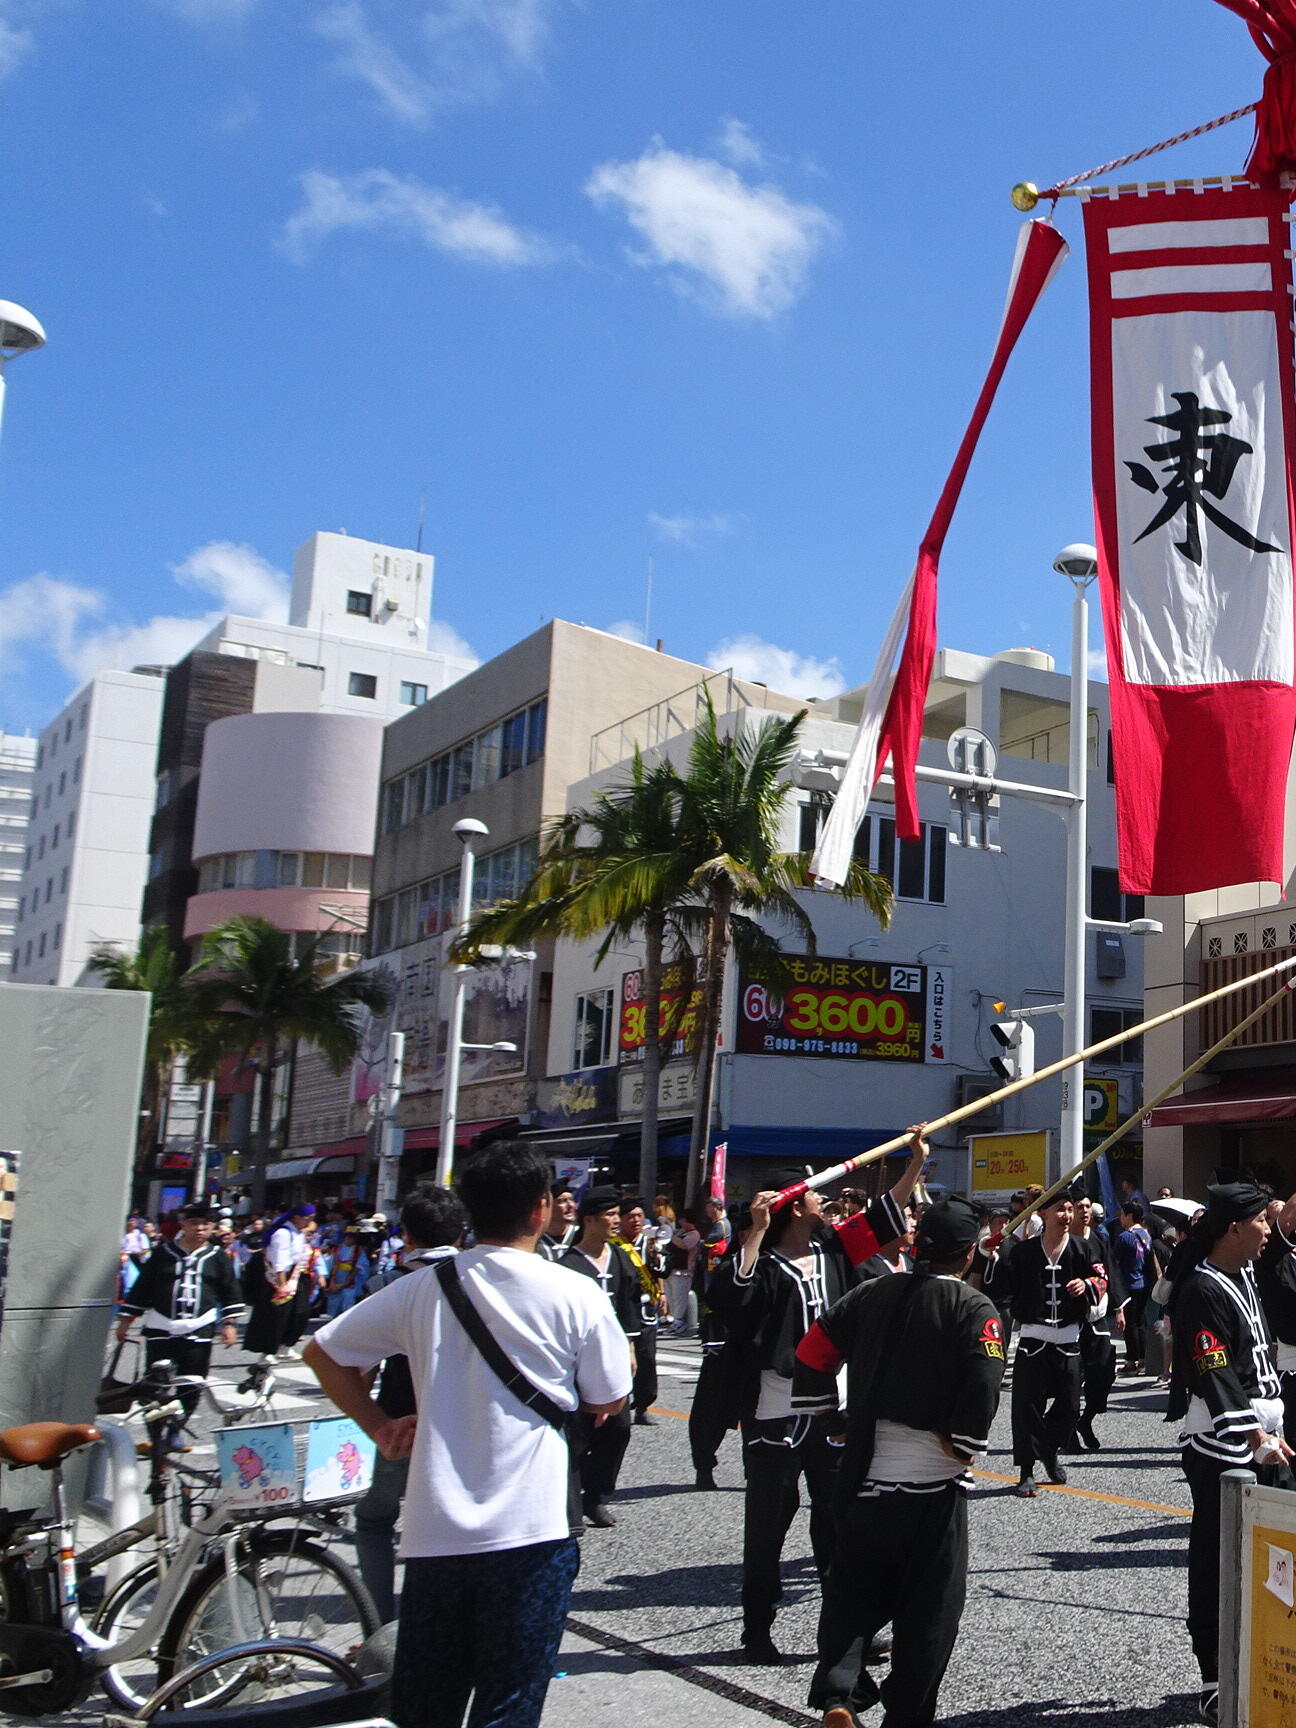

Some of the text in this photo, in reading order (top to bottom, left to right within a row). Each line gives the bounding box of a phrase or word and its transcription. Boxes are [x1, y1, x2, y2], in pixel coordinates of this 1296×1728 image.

[893, 969, 919, 989] 2F
[933, 971, 945, 1042] 入口はこちら
[1084, 1089, 1104, 1121] P
